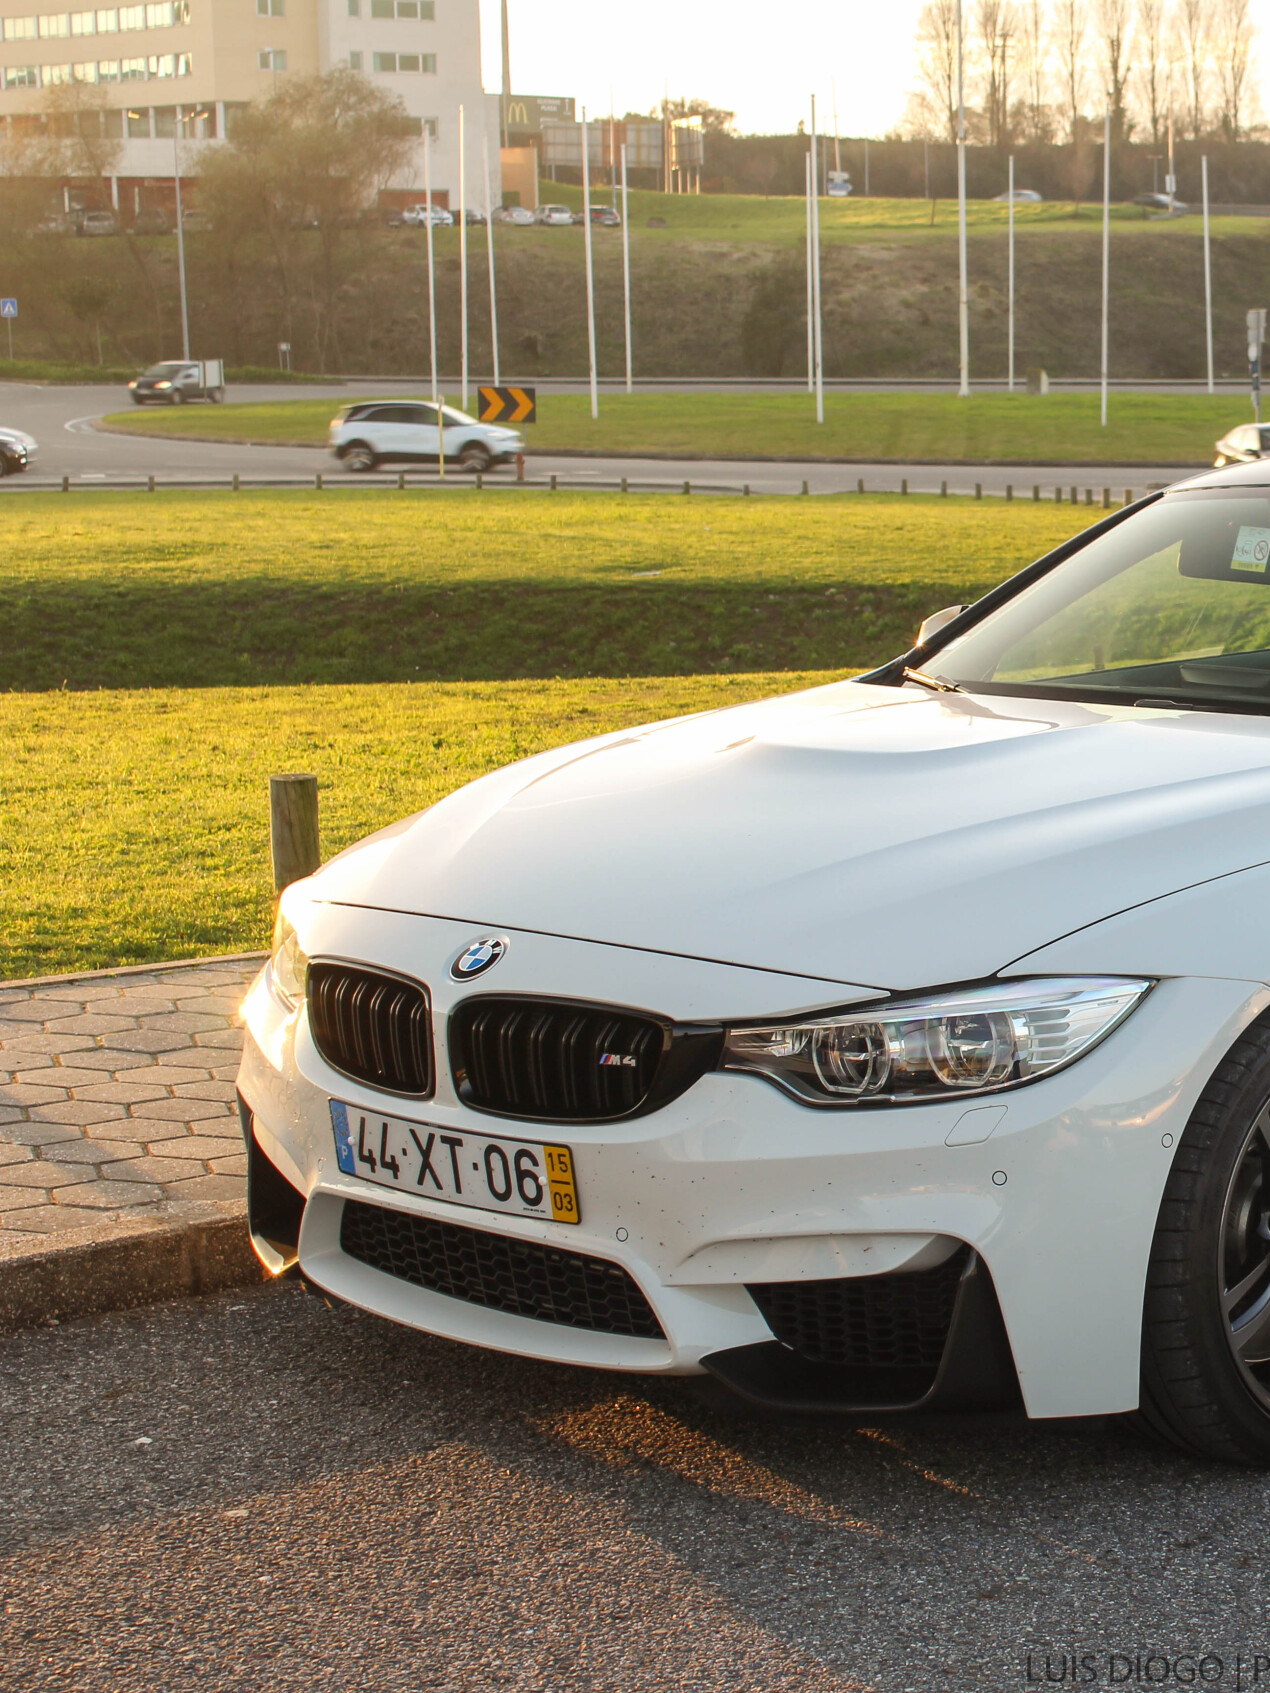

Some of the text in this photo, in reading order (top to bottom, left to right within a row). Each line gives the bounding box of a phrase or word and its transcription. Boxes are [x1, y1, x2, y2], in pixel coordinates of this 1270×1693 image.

[606, 1054, 636, 1066] M4
[341, 1145, 348, 1159] P
[548, 1152, 569, 1173] 15
[553, 1192, 574, 1212] 03
